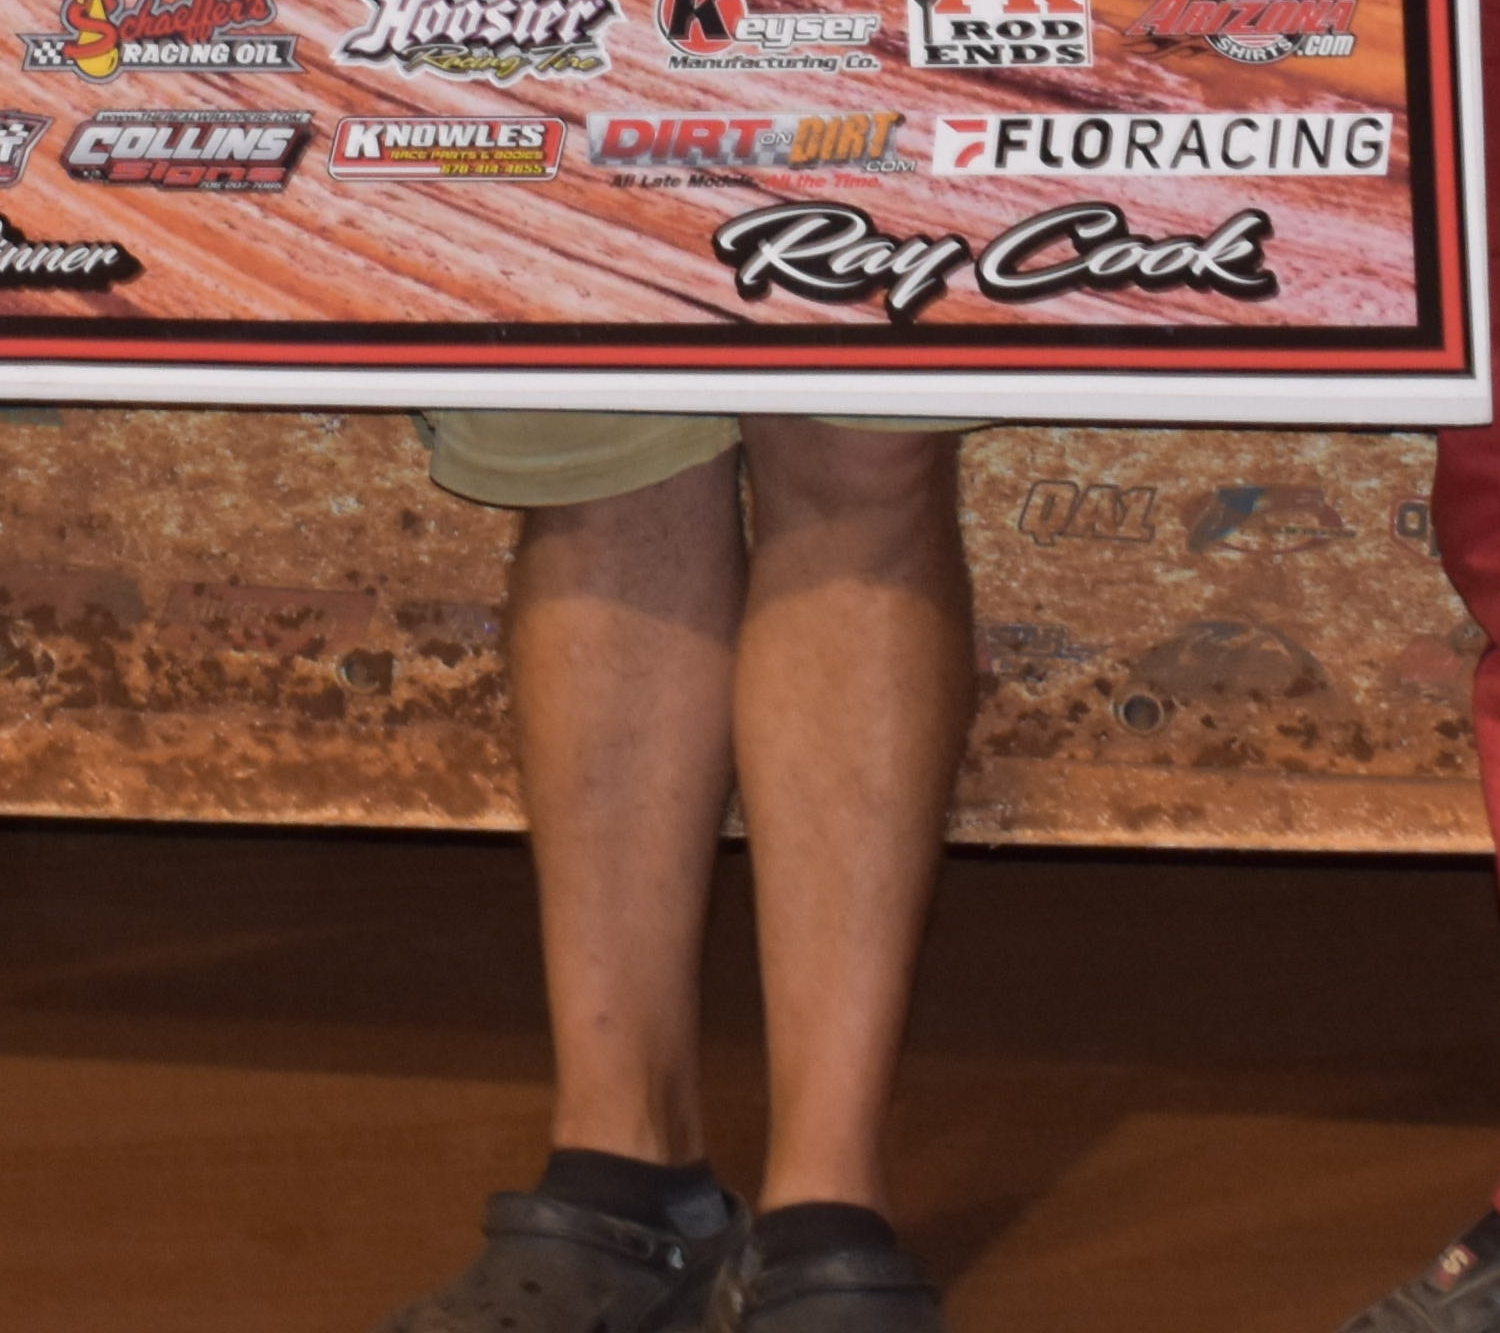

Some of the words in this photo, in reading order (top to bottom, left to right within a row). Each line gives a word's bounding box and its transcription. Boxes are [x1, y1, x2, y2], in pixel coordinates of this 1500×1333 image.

[949, 18, 1086, 42] ROD
[122, 41, 229, 65] RACING
[234, 40, 284, 65] OIL
[923, 43, 1087, 67] ENDS
[1214, 35, 1294, 63] SHIRTS
[667, 53, 838, 73] Manufacturing
[844, 52, 881, 70] Co.
[67, 126, 297, 165] COLLINS
[343, 123, 546, 159] KNOWLES
[601, 118, 773, 158] DIRT
[788, 112, 902, 165] DIRT
[992, 117, 1388, 171] FLORACING
[391, 149, 427, 161] RACE
[430, 149, 477, 161] PARTS
[611, 174, 636, 189] All
[639, 174, 684, 190] Late
[712, 199, 970, 317] Ray
[976, 200, 1278, 295] Cook
